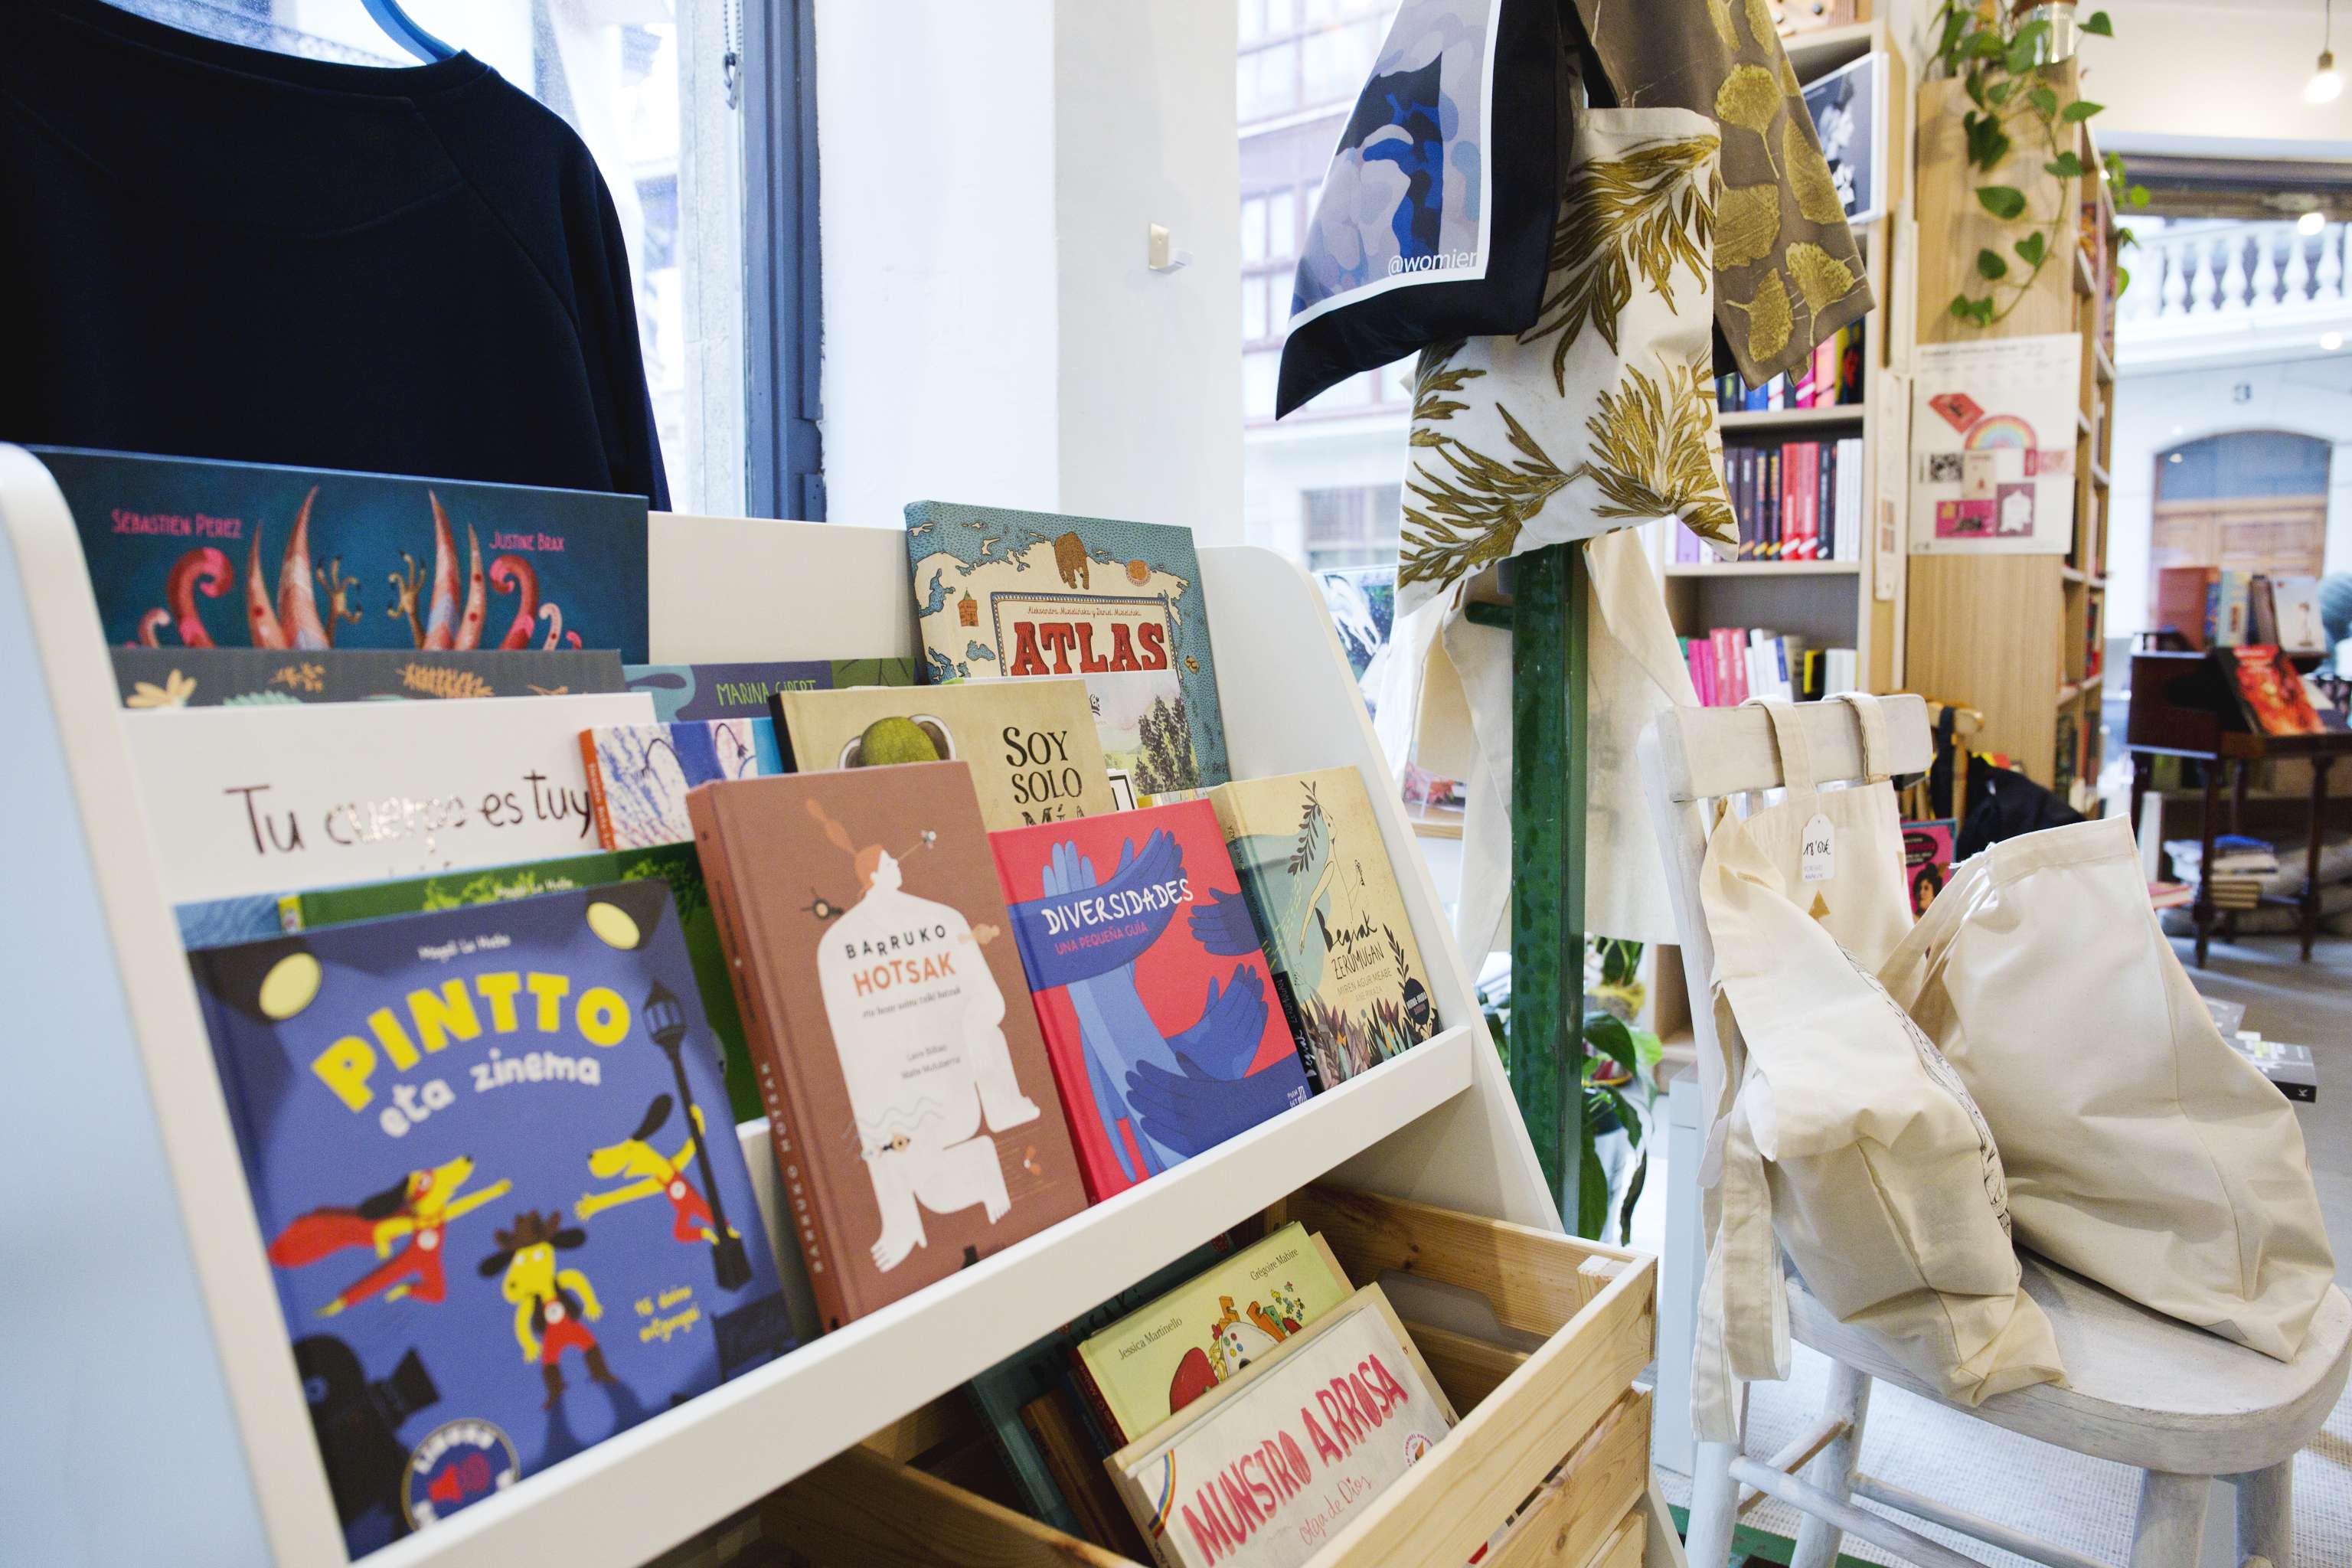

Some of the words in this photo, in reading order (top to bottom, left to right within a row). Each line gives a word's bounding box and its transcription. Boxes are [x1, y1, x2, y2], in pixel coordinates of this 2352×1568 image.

[1011, 621, 1168, 676] ATLAS
[715, 681, 770, 707] MARINA
[1002, 726, 1069, 767] SOY
[1011, 767, 1083, 805] SOLO
[225, 783, 305, 854] Tu
[478, 792, 524, 828] es
[523, 769, 591, 839] tuy
[1040, 877, 1194, 936] DIVERSIDADES
[845, 924, 946, 959] BARRUKO
[1054, 940, 1078, 956] UNA
[1079, 926, 1124, 949] PEQUEÑA
[1124, 920, 1148, 937] GUÍA
[852, 951, 956, 998] HOTSAK
[1331, 942, 1384, 980] ZERUMUGAN
[309, 970, 631, 1114] PINTTO
[379, 1079, 456, 1138] eta
[469, 1047, 601, 1093] zinema
[1250, 1261, 1279, 1282] Grégoire
[1276, 1249, 1299, 1266] Mabire
[1118, 1340, 1147, 1361] Jessica
[1143, 1317, 1183, 1344] Martinello
[1181, 1429, 1312, 1568] MUNSTRO
[1300, 1353, 1409, 1468] ARROSA
[1323, 1494, 1347, 1520] de
[1335, 1475, 1373, 1504] Dios
